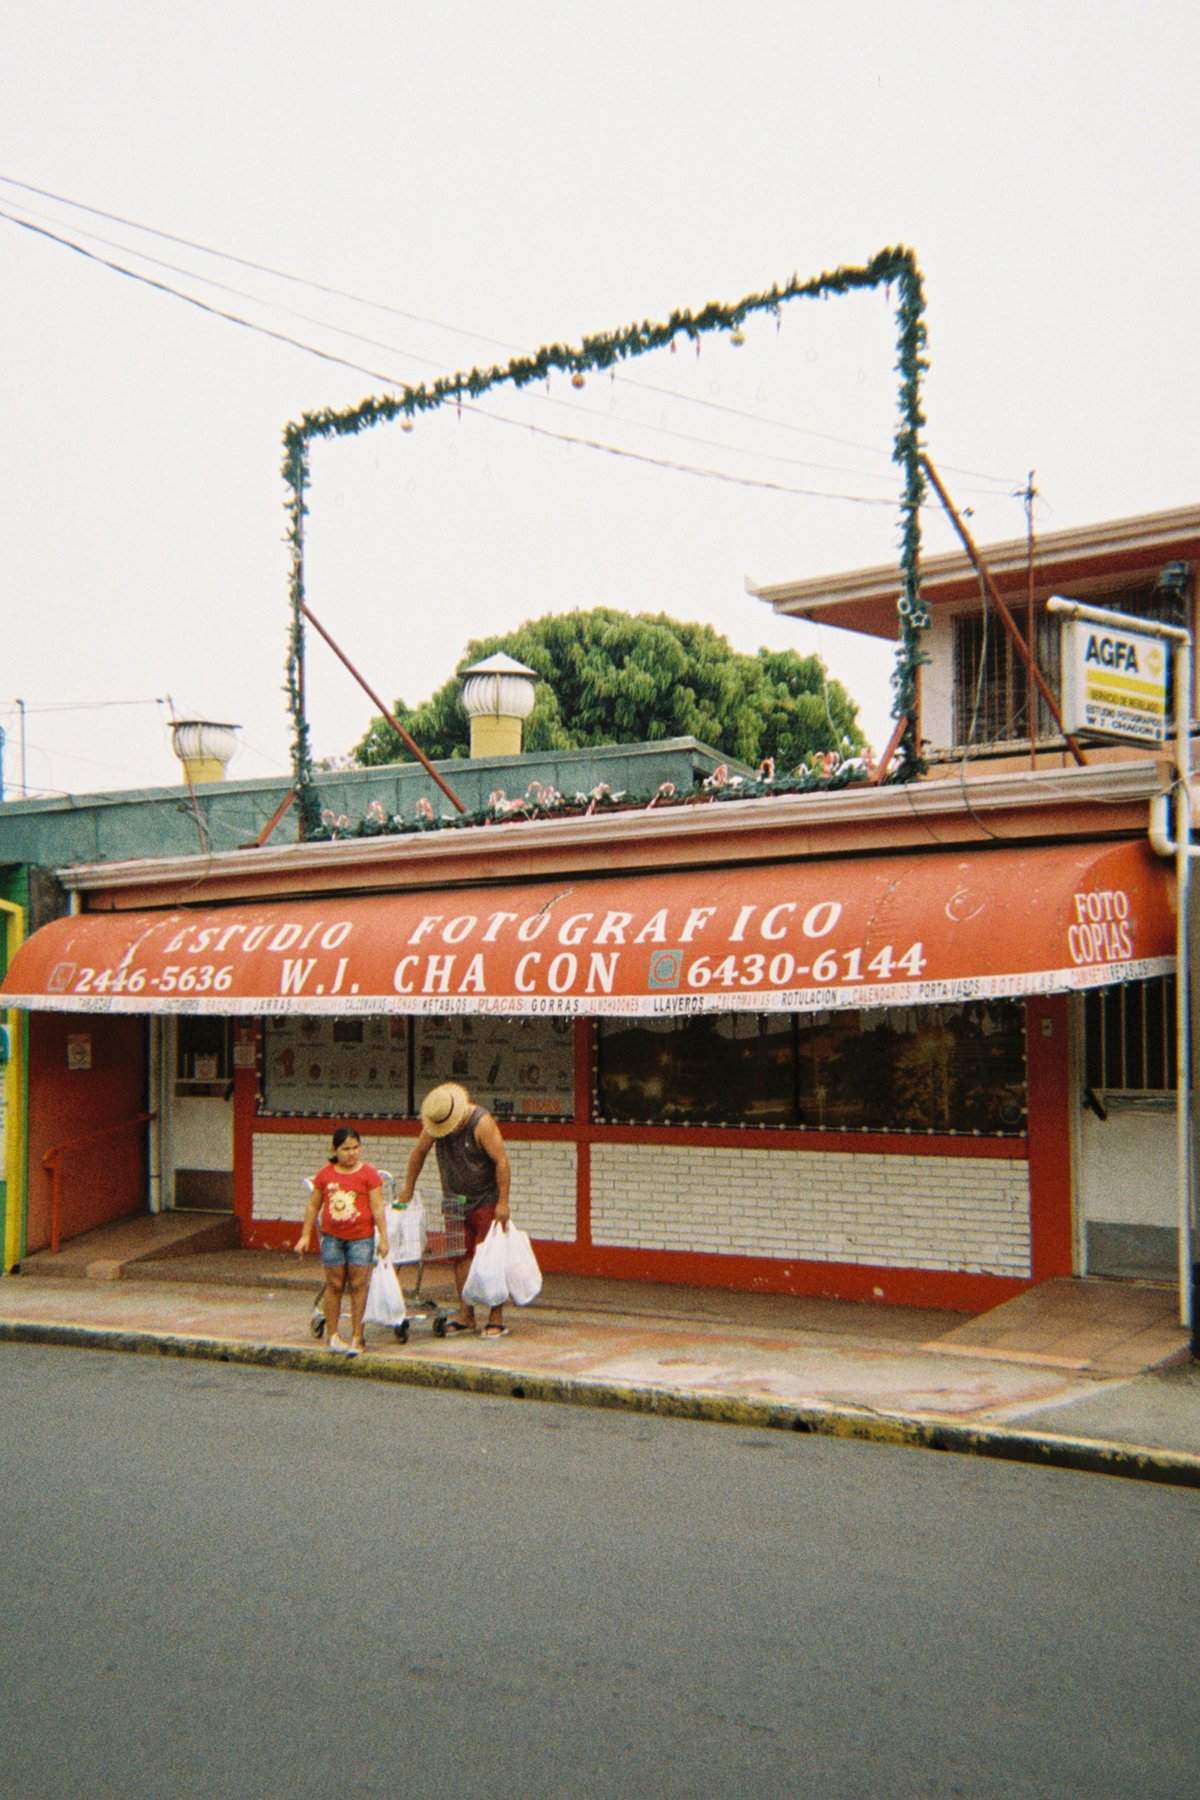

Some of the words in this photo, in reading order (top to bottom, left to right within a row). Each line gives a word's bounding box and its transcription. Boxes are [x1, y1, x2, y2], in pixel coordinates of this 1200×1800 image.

[1085, 635, 1139, 673] AGFA
[1074, 890, 1129, 922] FOTO
[164, 921, 352, 953] ESTUDIO
[1067, 921, 1134, 964] COPIAS
[74, 965, 234, 993] 2446-5636
[687, 942, 926, 987] 6430-6144
[422, 998, 467, 1011] RETABLOS
[478, 998, 523, 1011] PLACAS
[532, 999, 579, 1012] GORRAS
[653, 996, 704, 1012] LLAVEROS
[781, 990, 837, 1006] ROTULACION
[852, 985, 912, 1003] CALENDARIOS
[990, 973, 1054, 993] BOTELLAS
